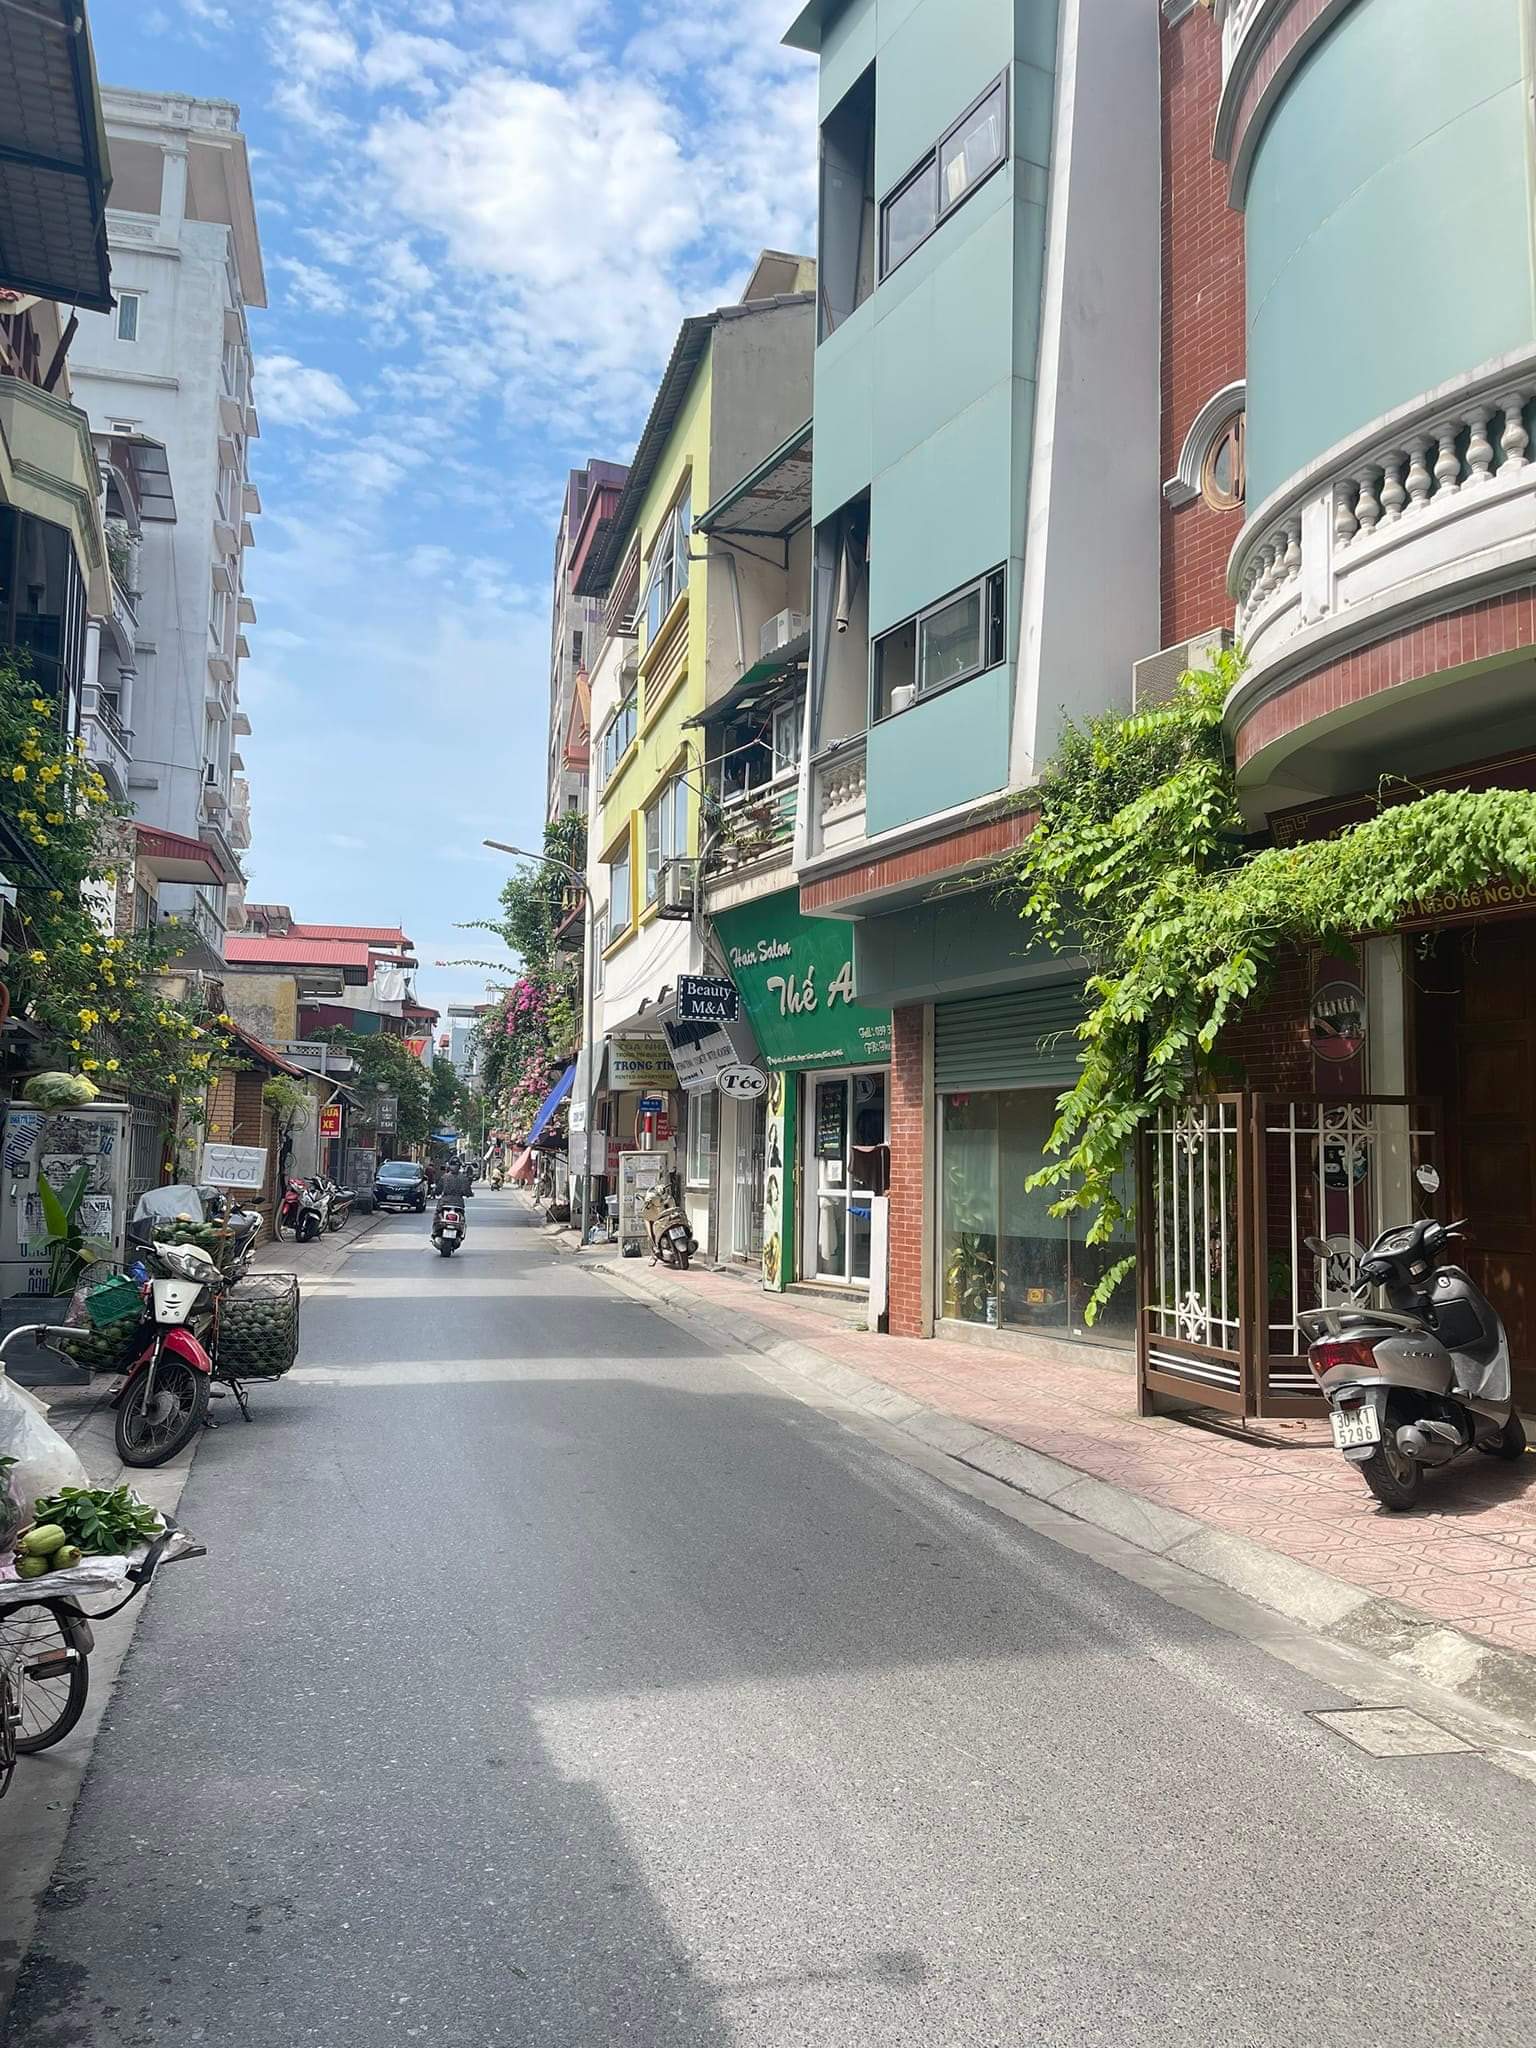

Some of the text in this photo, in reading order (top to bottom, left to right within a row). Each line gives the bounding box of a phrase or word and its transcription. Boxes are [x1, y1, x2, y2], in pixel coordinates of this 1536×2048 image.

[1461, 890, 1481, 908] 66
[730, 938, 791, 969] Hair Salon
[687, 981, 732, 1000] Beauty
[767, 965, 818, 1016] Thế
[691, 1000, 726, 1015] M&A
[613, 1060, 653, 1073] TRỌNG
[724, 1076, 762, 1090] Tóc
[323, 1119, 335, 1129] XE
[1339, 1425, 1373, 1444] 5296
